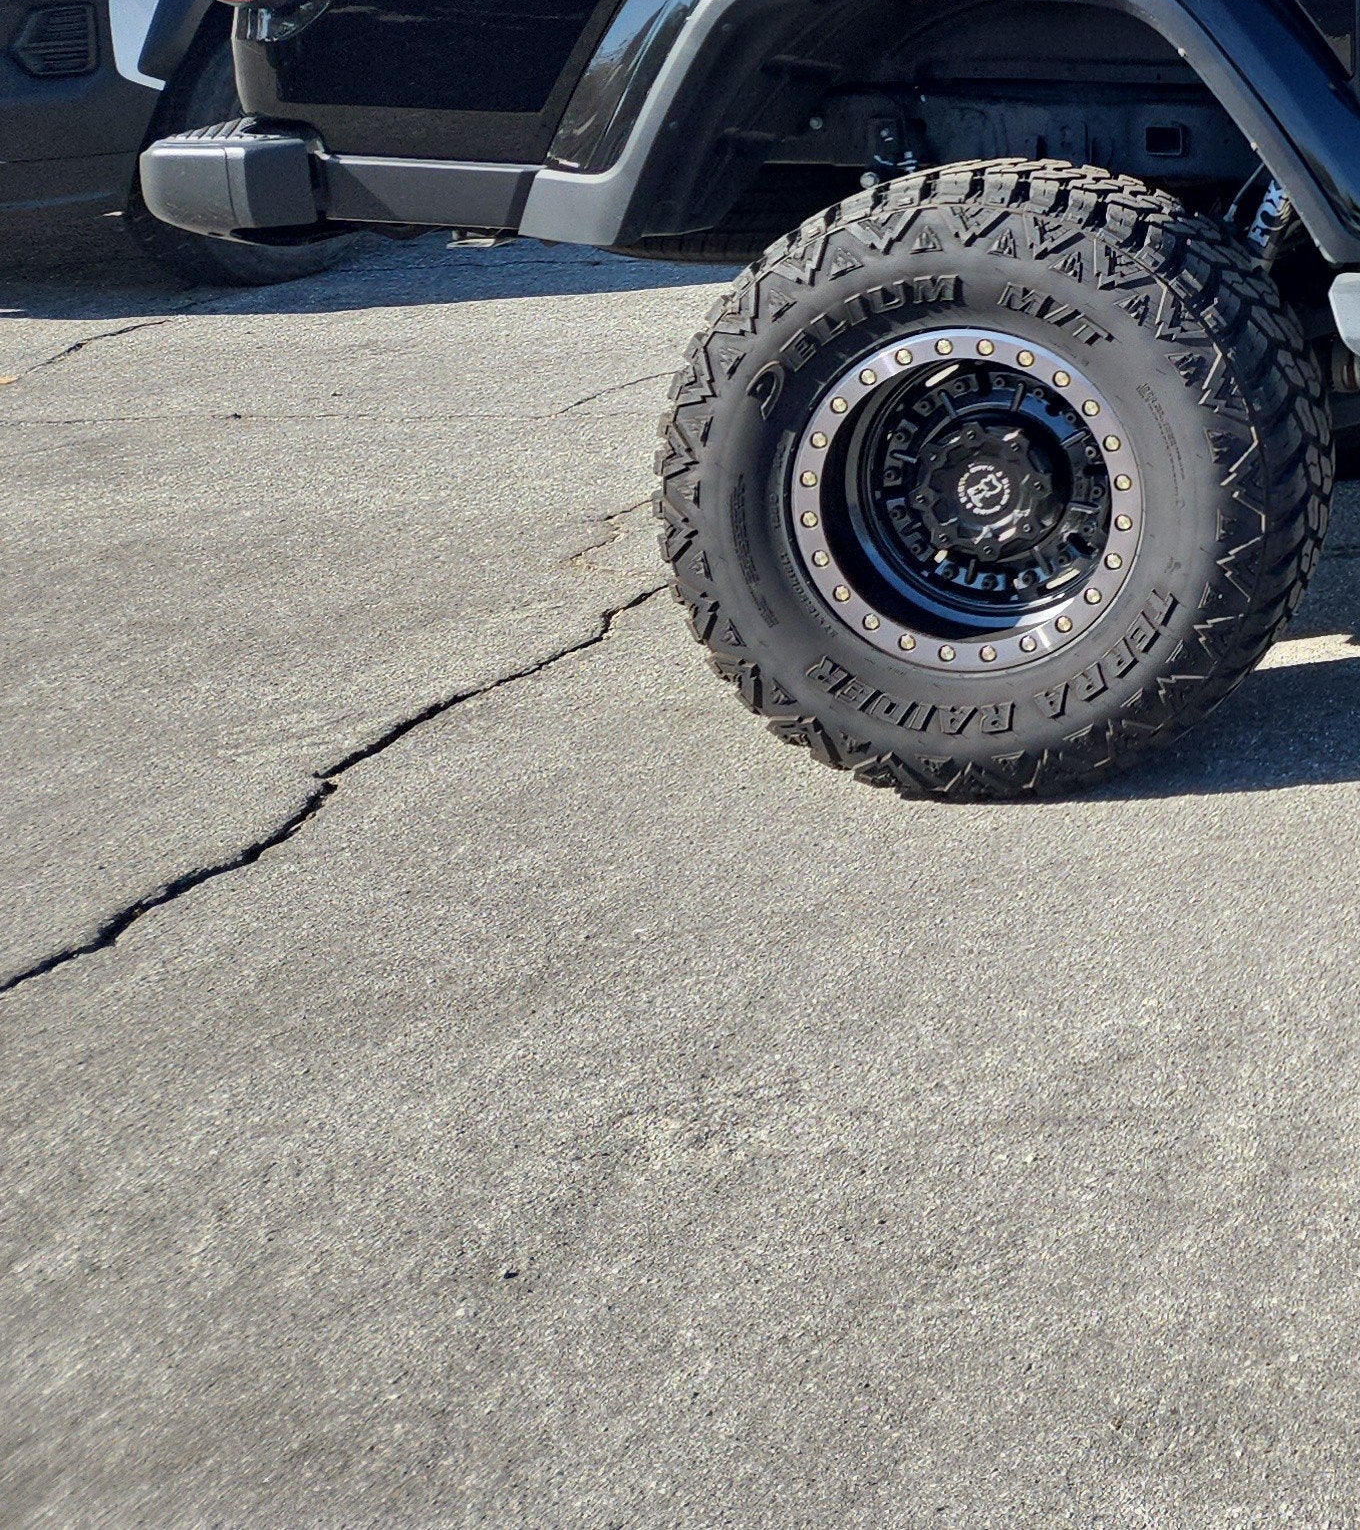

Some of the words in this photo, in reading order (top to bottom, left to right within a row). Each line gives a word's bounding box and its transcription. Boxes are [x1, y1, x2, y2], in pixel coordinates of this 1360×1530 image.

[746, 274, 963, 419] DELIUM
[997, 280, 1121, 346] M/T
[806, 655, 1016, 734] RAIDER
[1033, 588, 1178, 719] TERRA
